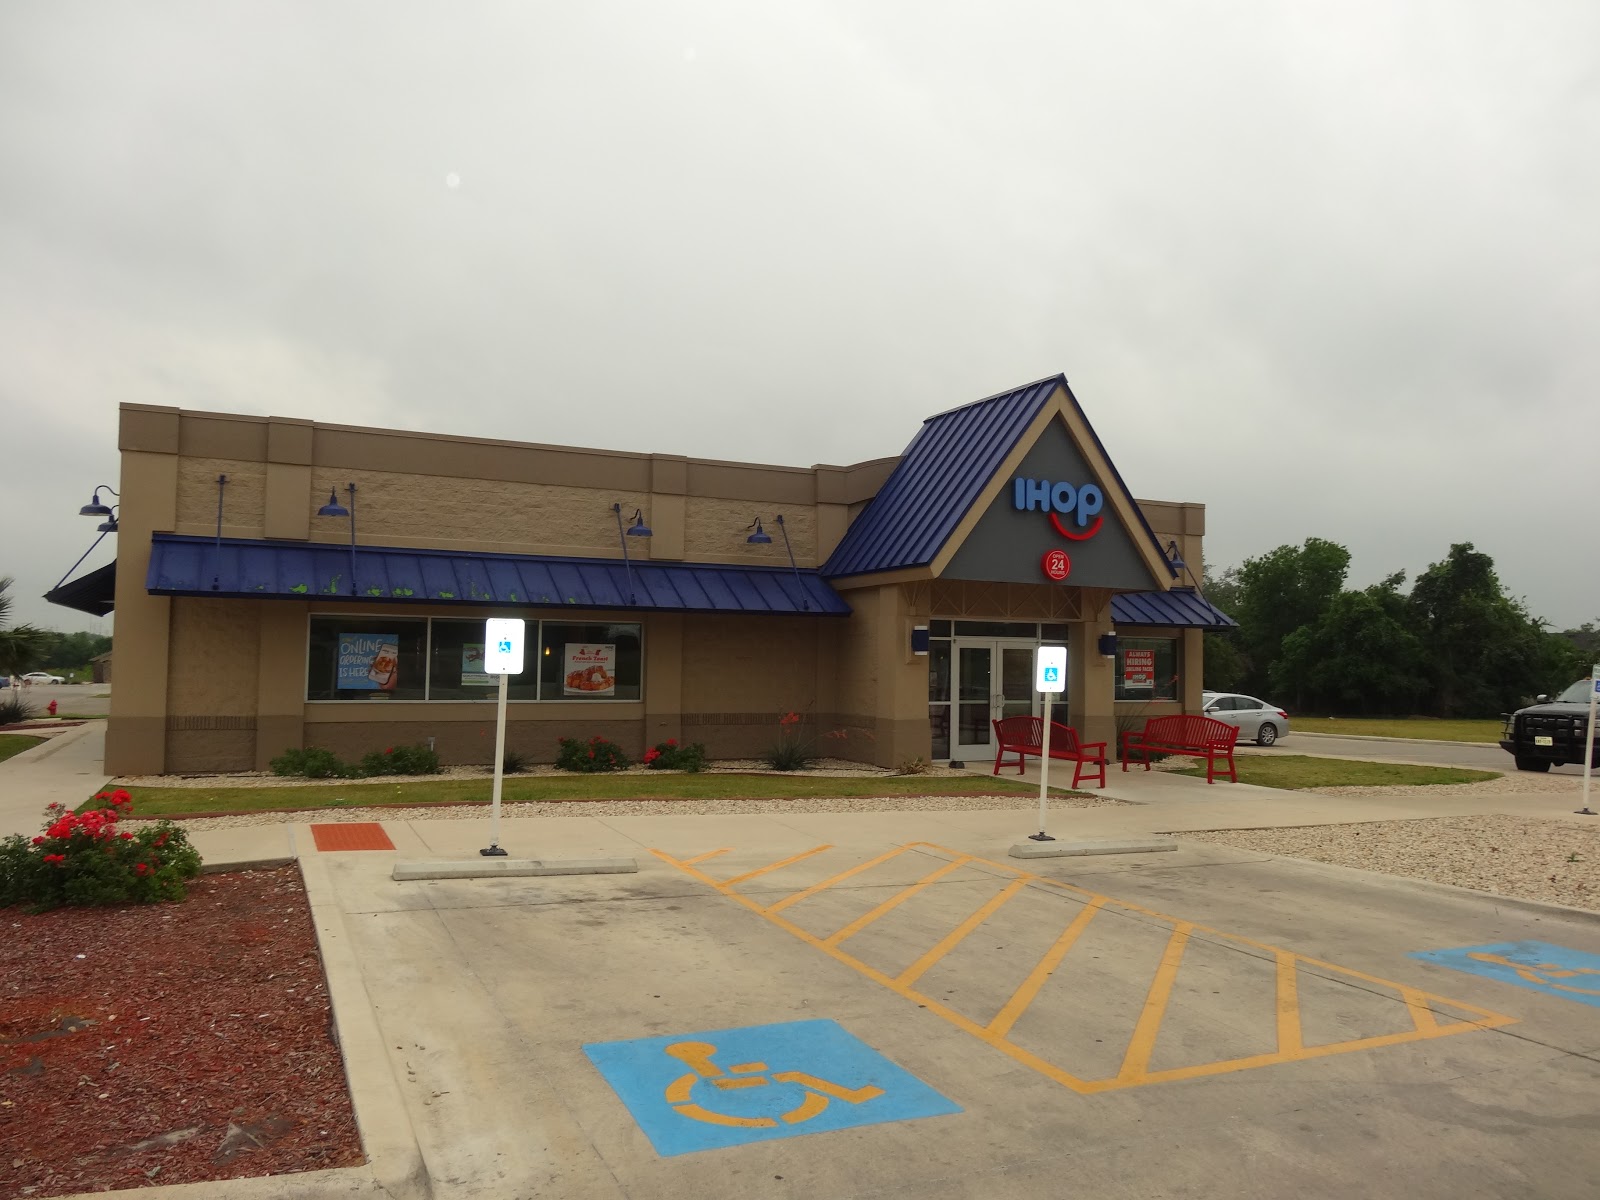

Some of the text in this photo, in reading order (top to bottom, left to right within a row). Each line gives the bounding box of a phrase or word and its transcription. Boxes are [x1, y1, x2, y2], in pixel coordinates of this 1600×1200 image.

[1014, 477, 1103, 527] IHOP
[1051, 559, 1065, 570] 24
[341, 639, 383, 655] ONLINE
[339, 655, 375, 665] ORDERING
[1126, 658, 1152, 666] HIRING
[339, 667, 369, 677] IS HERE
